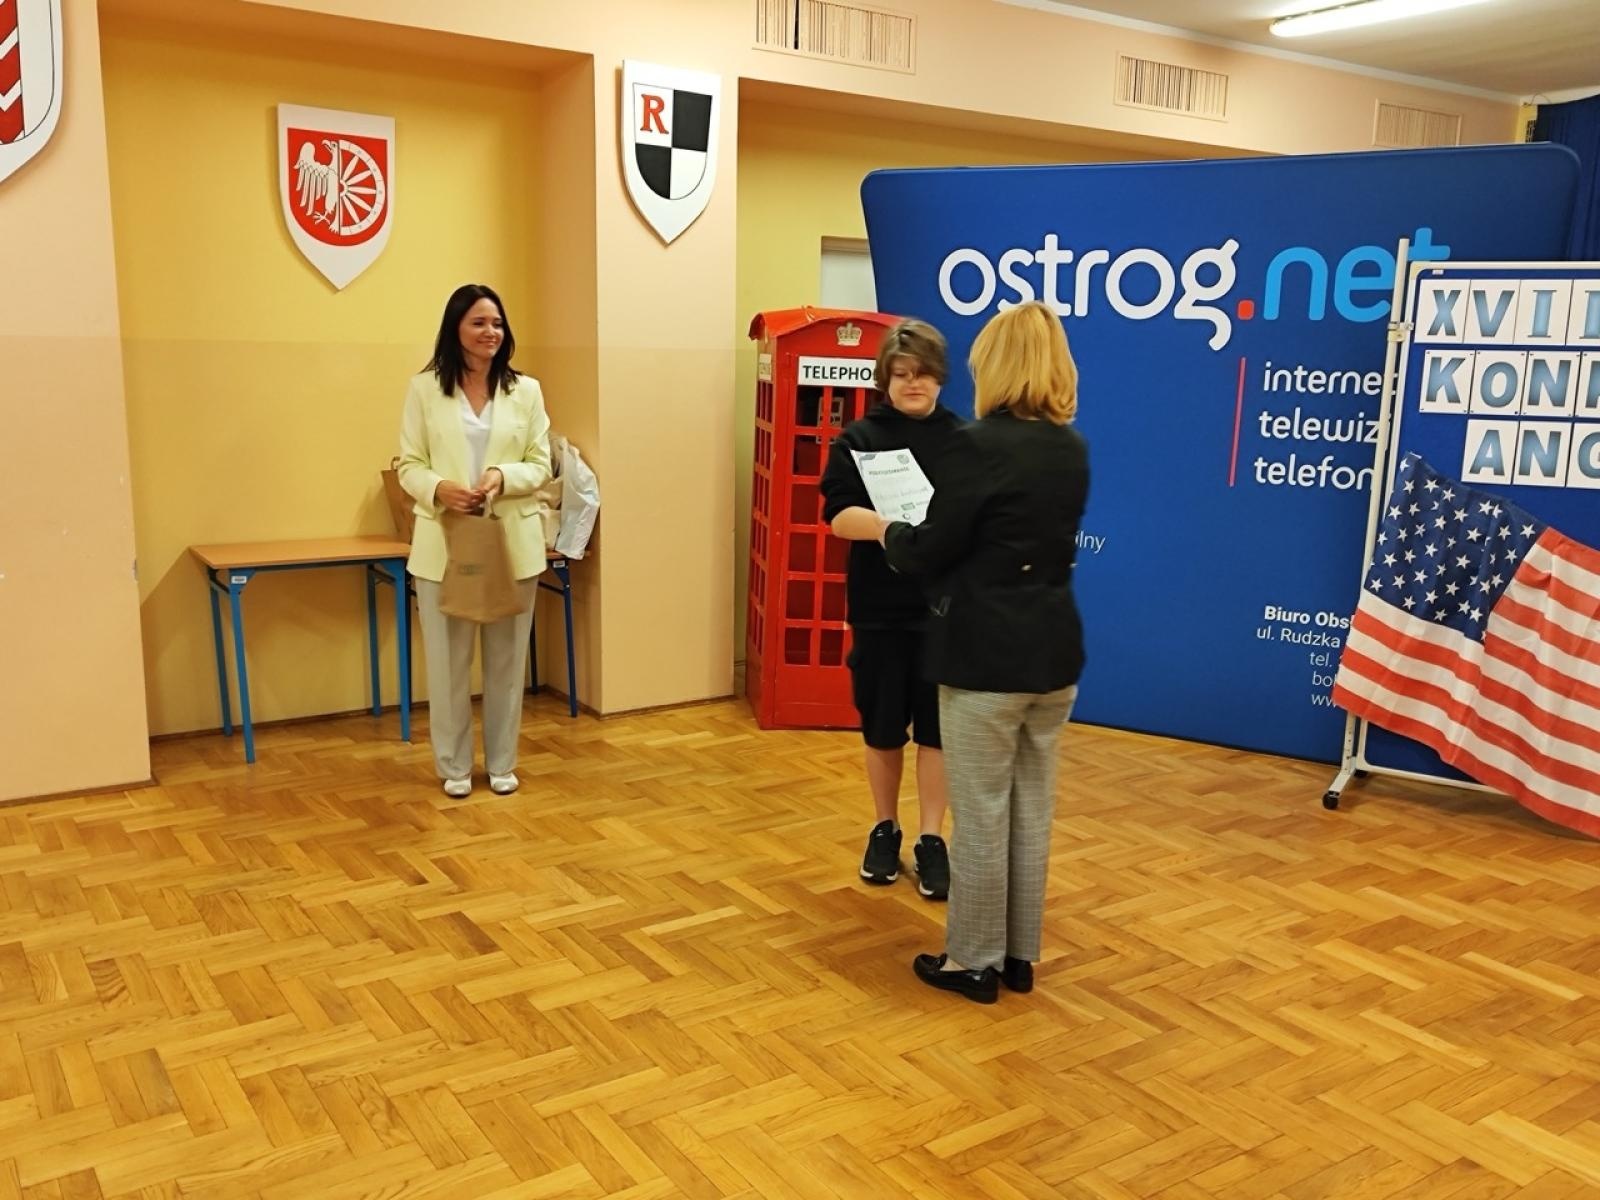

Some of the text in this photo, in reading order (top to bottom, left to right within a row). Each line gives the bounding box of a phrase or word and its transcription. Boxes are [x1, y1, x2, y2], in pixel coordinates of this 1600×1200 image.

[640, 93, 669, 135] R
[803, 365, 876, 381] TELEPHO
[1259, 407, 1391, 444] telewiz
[1264, 605, 1354, 630] Biuro Obs
[1256, 625, 1341, 649] ul. Rudzka
[1310, 652, 1333, 668] tel.
